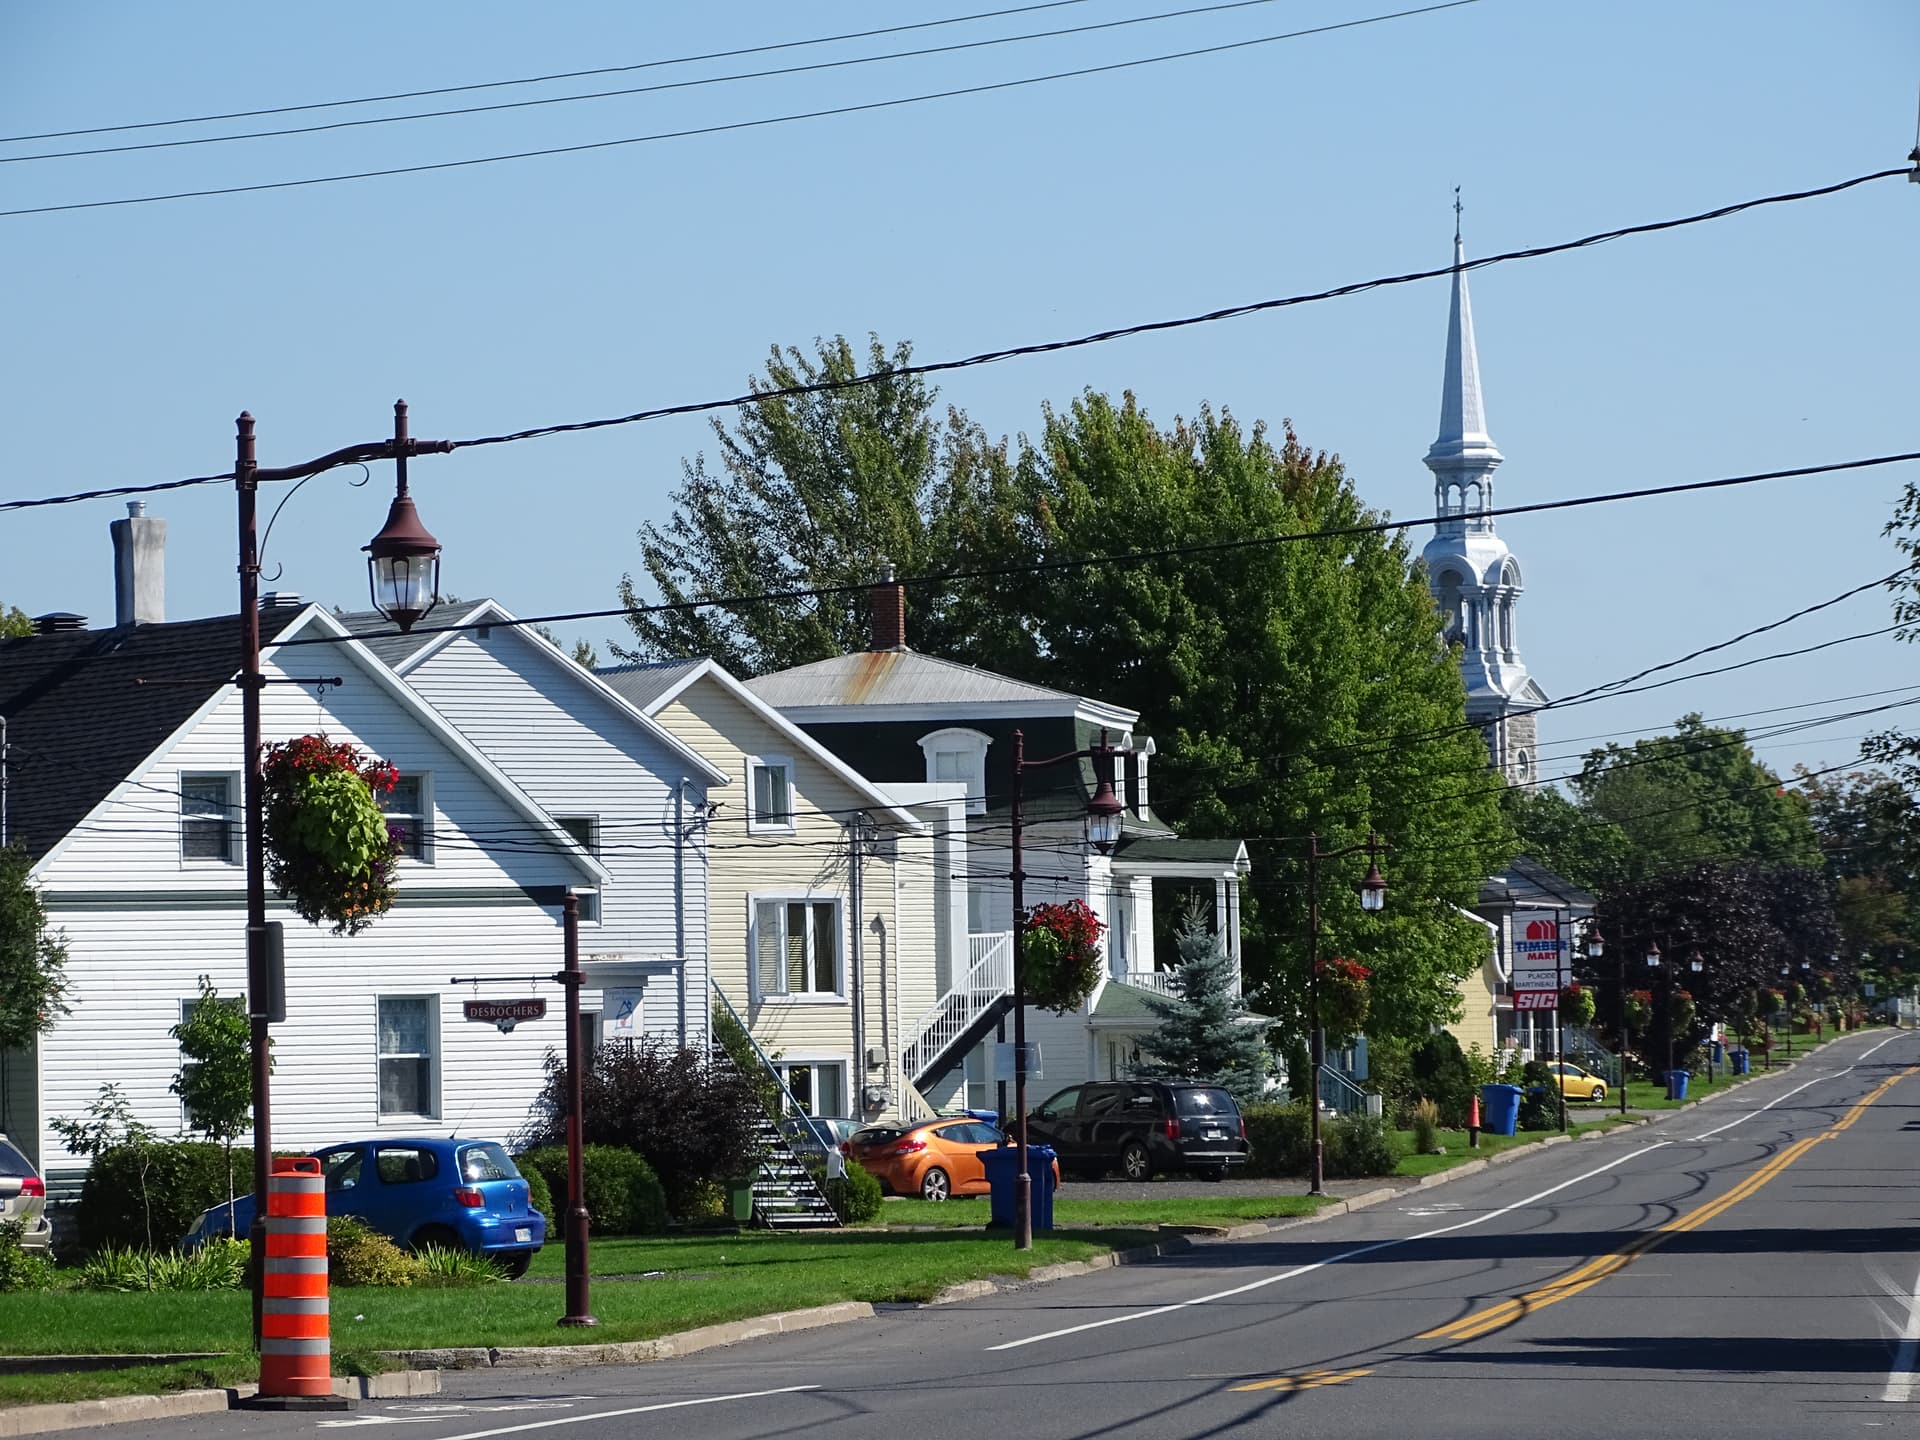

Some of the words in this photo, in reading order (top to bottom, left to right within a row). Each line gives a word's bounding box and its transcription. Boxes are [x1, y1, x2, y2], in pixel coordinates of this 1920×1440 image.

[1515, 940, 1567, 952] TIMBER
[1528, 952, 1557, 960] MART
[470, 1006, 539, 1017] DESROCHERS
